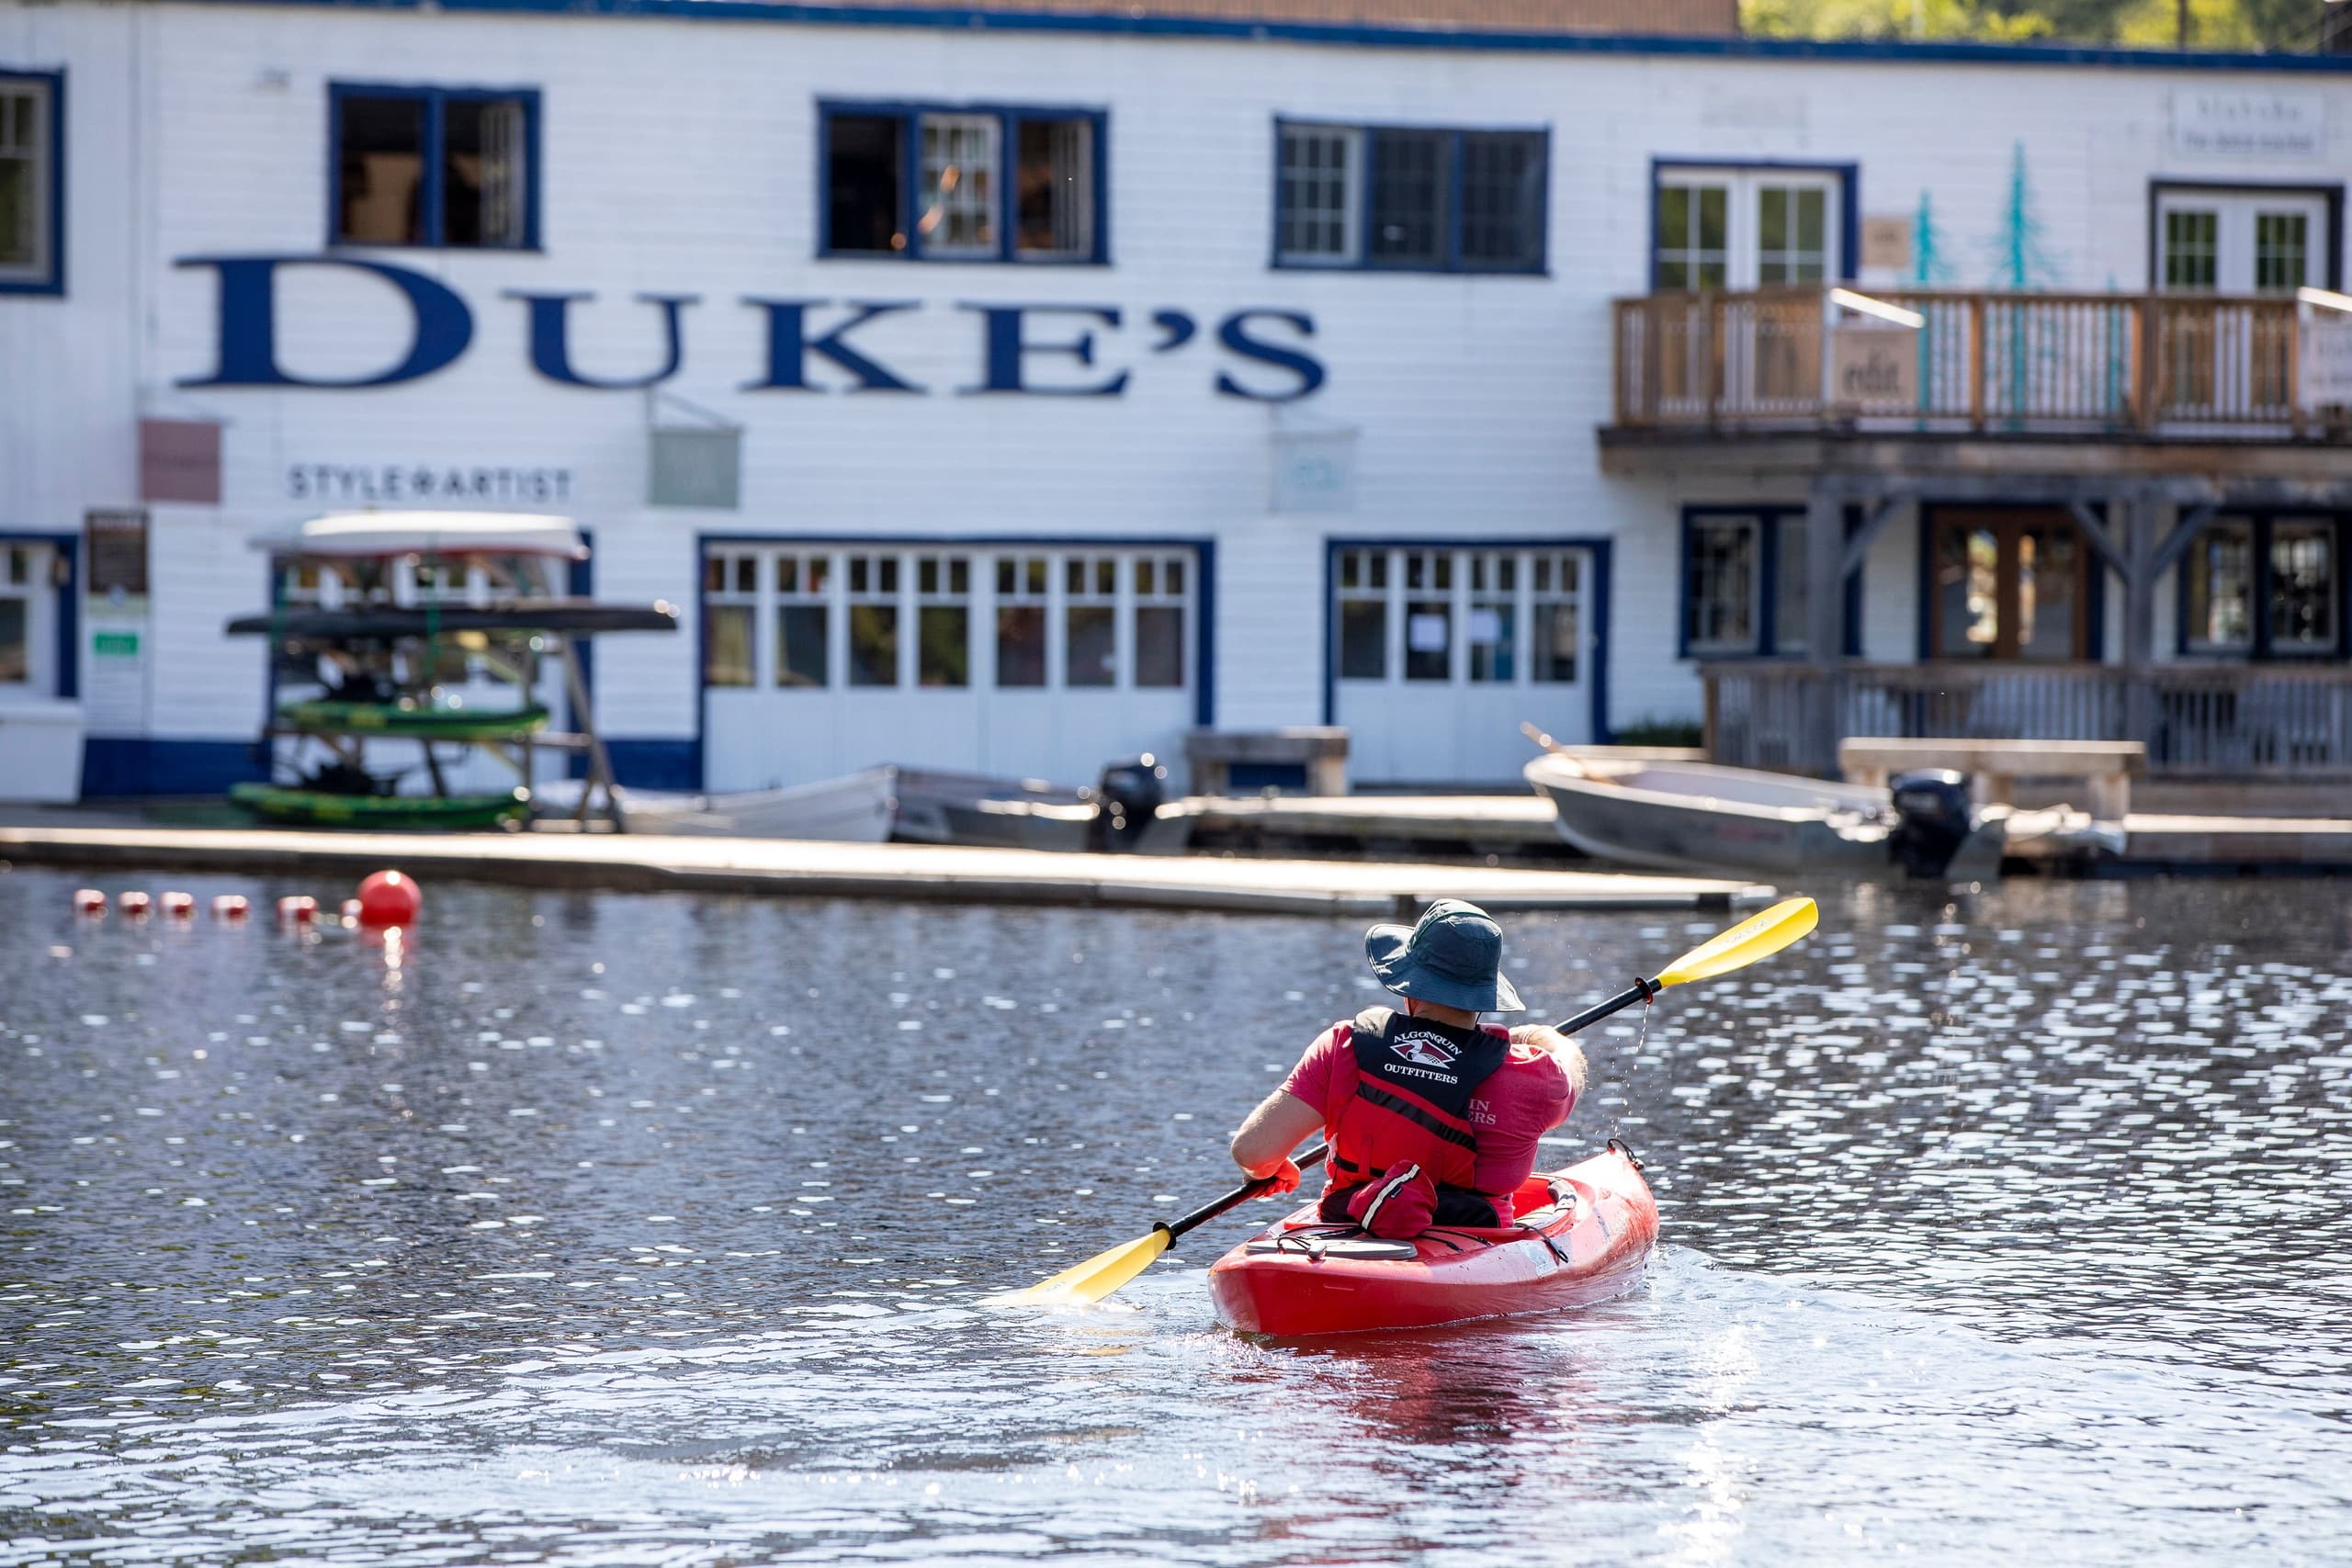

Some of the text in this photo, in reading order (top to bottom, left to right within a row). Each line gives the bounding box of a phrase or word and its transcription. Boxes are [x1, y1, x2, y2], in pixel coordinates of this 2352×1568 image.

[175, 254, 1329, 402] DUKE'S
[1394, 1031, 1463, 1055] ALGONQUIN
[1384, 1063, 1459, 1085] OUTFITTERS
